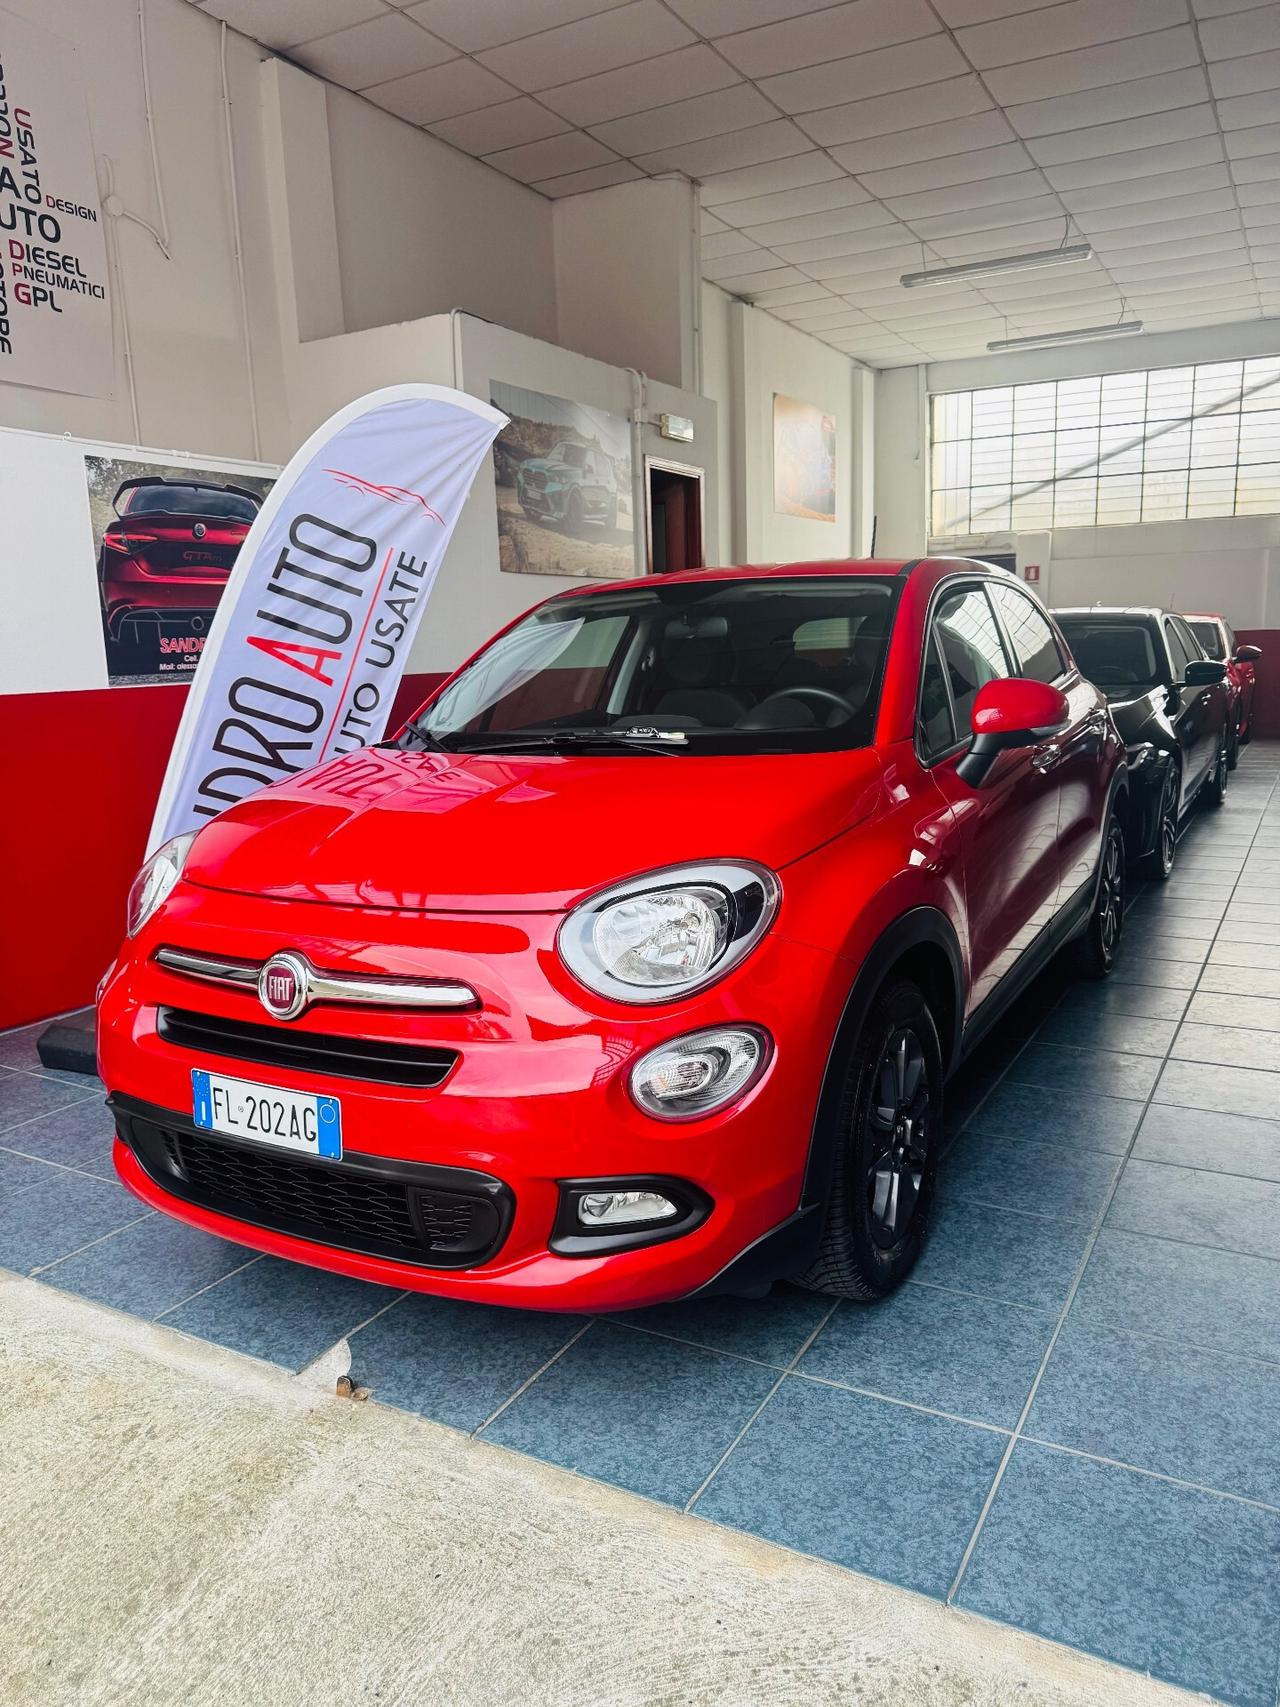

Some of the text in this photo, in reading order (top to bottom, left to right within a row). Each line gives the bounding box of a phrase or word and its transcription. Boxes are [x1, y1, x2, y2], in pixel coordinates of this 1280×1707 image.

[13, 107, 42, 205] USATO
[45, 194, 97, 223] DESIGN
[8, 238, 87, 278] DIESEL
[12, 262, 105, 300] PNEUMATICI
[14, 282, 63, 313] GPL
[364, 551, 428, 669] USATE
[268, 975, 293, 1001] FIAT
